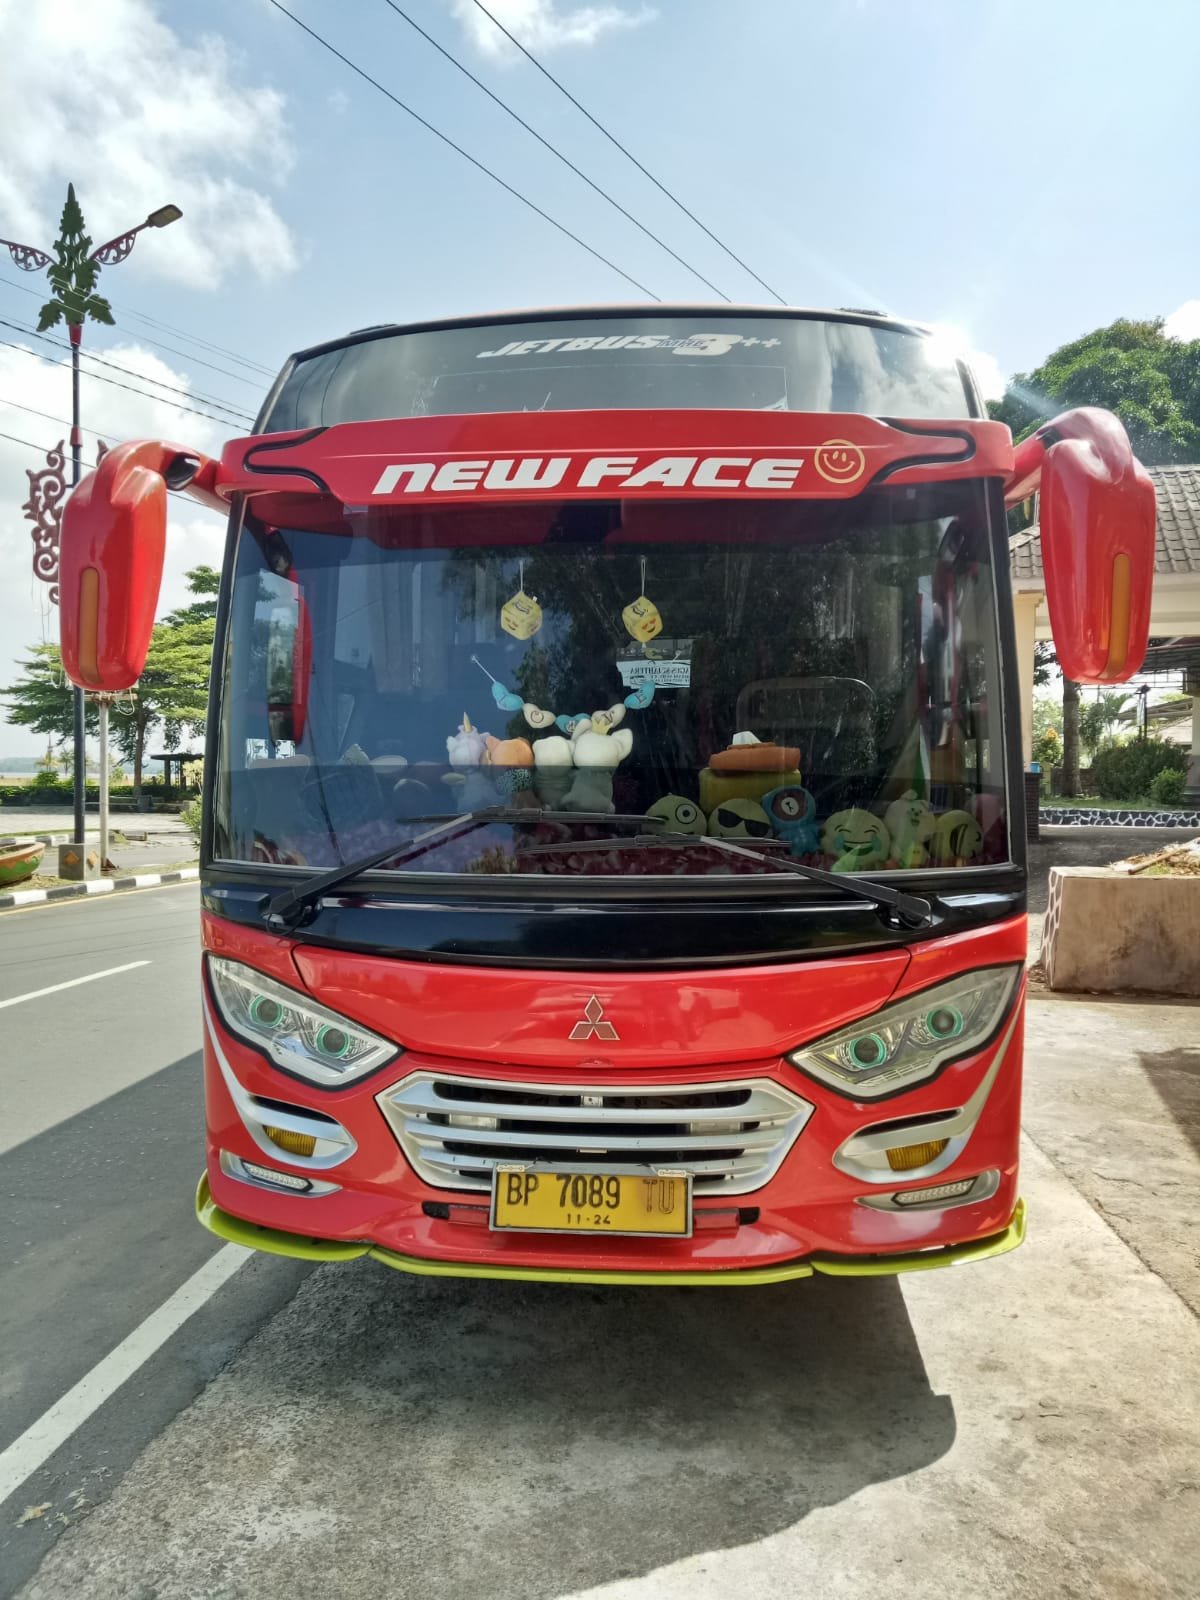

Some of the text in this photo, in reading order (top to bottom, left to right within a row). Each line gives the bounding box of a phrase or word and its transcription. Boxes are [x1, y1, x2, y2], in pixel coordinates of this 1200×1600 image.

[476, 335, 670, 358] JETBUS
[372, 456, 804, 494] NEW FACE
[506, 1173, 675, 1214] BP 7089 TU
